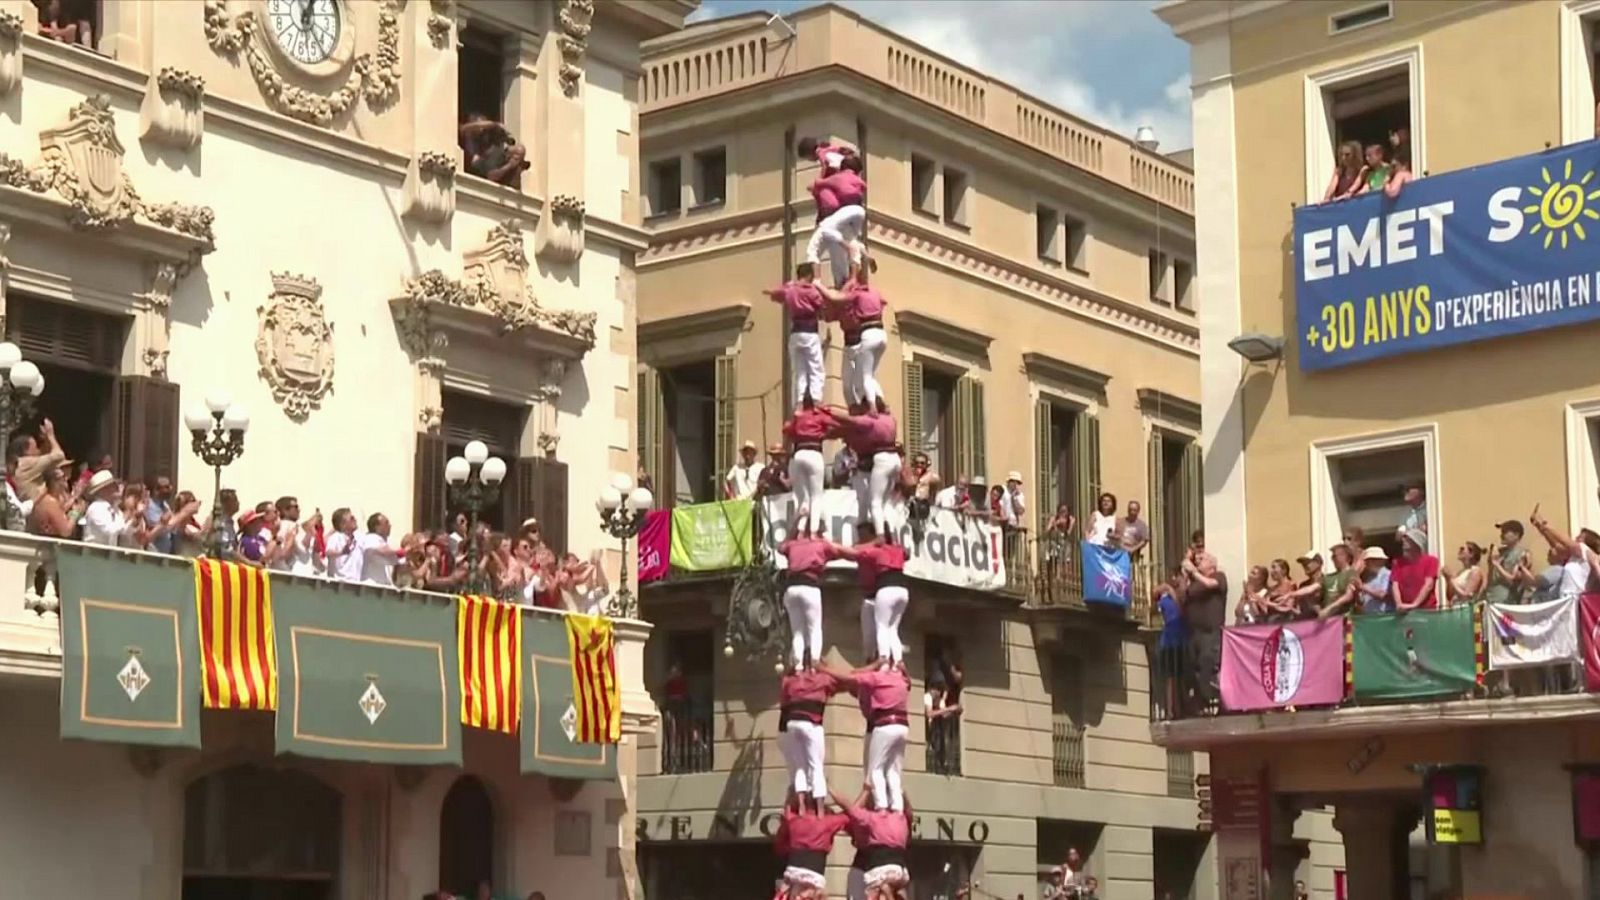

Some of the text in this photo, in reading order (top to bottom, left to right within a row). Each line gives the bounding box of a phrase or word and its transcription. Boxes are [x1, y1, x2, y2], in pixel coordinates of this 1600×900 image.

[276, 16, 282, 31] 8
[323, 16, 330, 31] 3
[287, 32, 293, 47] 7
[297, 41, 305, 56] 6
[310, 41, 317, 56] 5
[1303, 201, 1454, 282] EMET
[1306, 302, 1355, 353] +30
[1363, 285, 1431, 345] ANYS
[1435, 280, 1563, 331] D'EXPERIÈNCIA
[1568, 273, 1590, 307] EN
